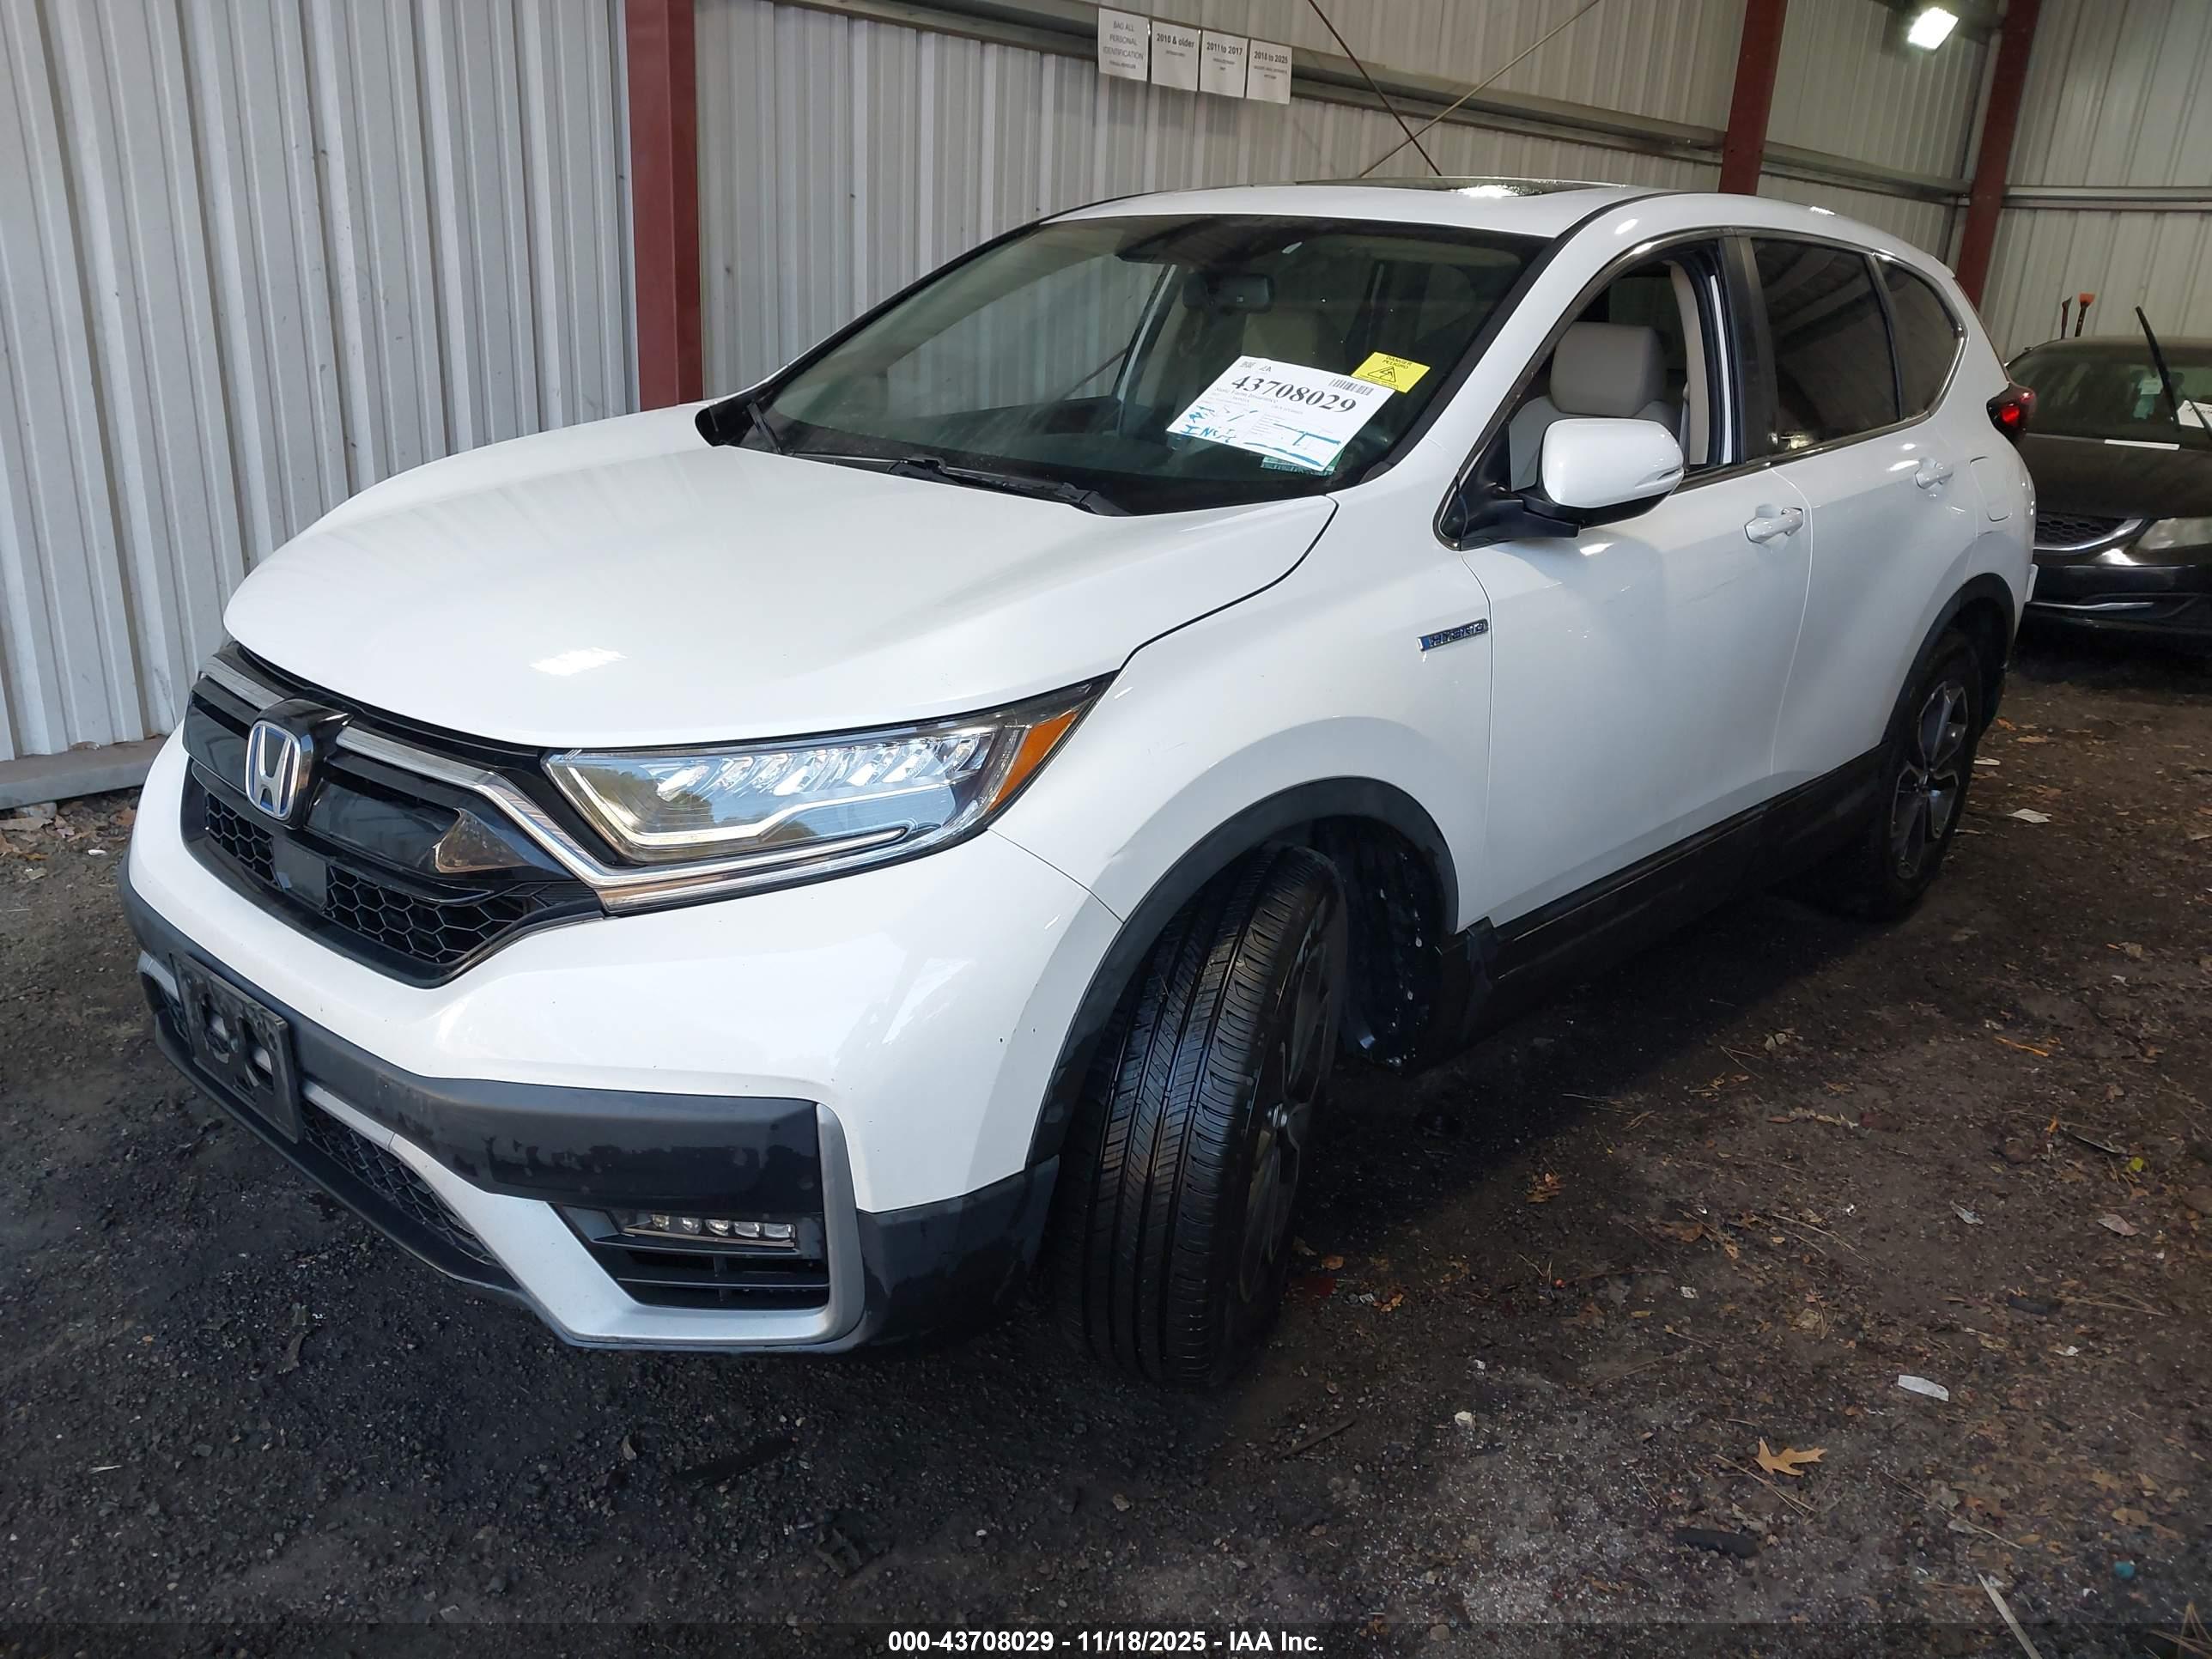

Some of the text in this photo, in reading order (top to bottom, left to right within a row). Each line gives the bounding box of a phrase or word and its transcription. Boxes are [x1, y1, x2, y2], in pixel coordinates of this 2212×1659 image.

[1125, 23, 1134, 32] ALL
[1109, 33, 1138, 46] PERSONAL
[1156, 33, 1195, 48] 2010 & older
[1103, 46, 1145, 60] IDENTIFICATION
[1206, 41, 1243, 55] 2011 to 2017
[1253, 51, 1288, 64] 2018 to 2025
[1385, 356, 1413, 367] DANGER
[1231, 375, 1357, 412] 43708029
